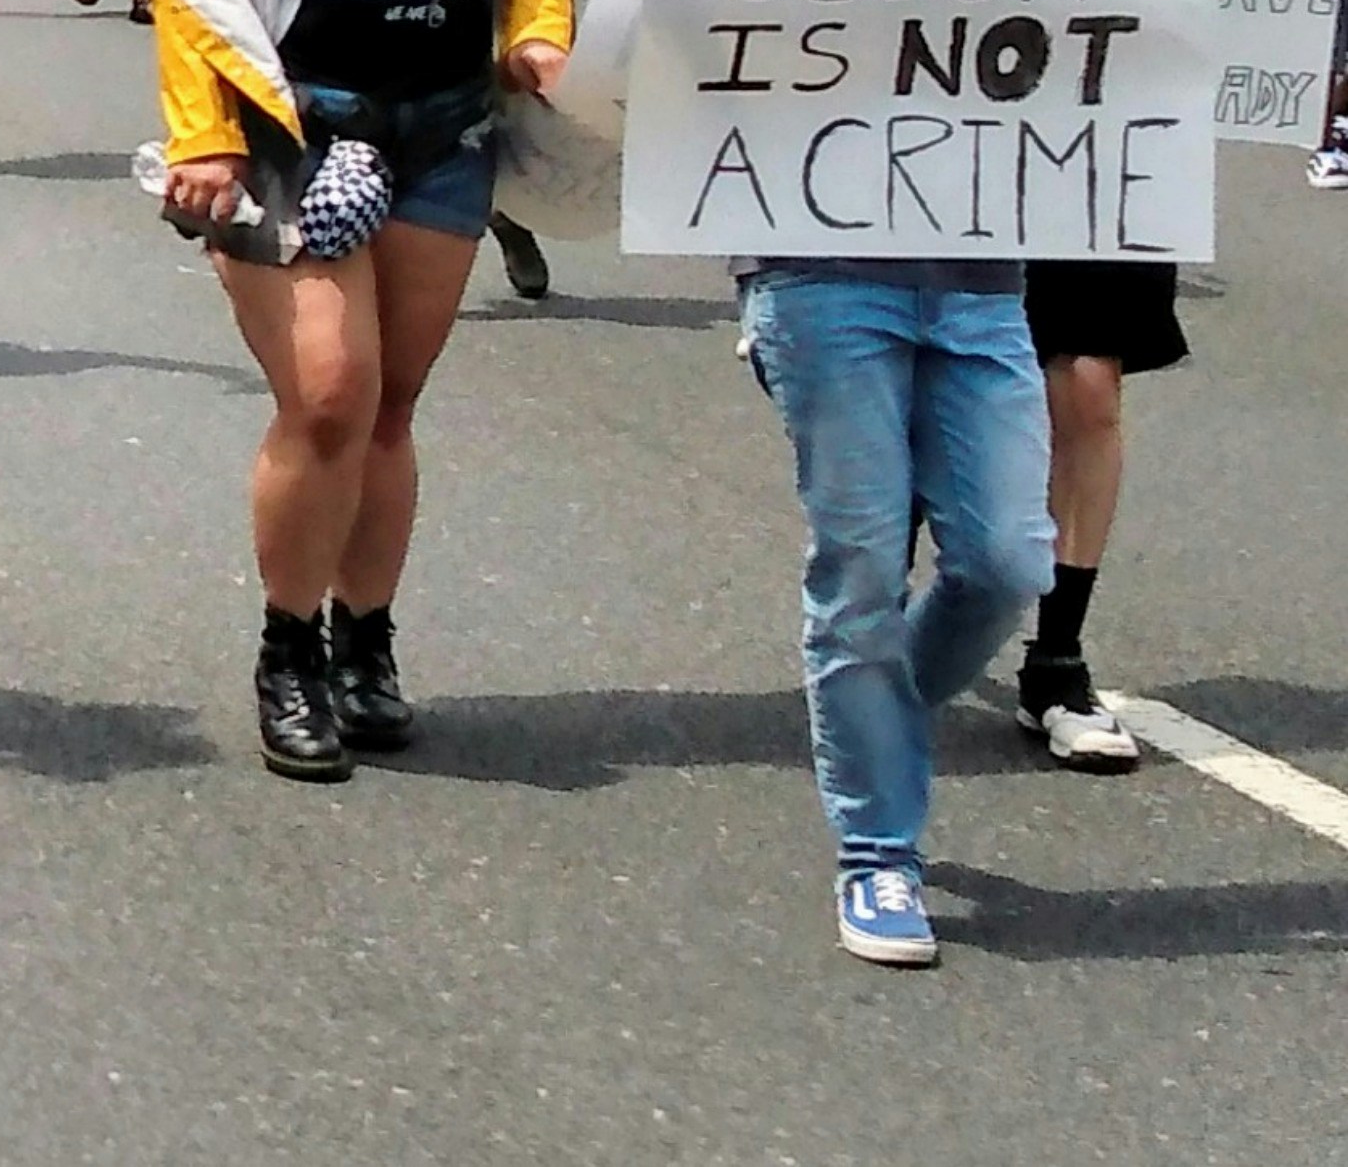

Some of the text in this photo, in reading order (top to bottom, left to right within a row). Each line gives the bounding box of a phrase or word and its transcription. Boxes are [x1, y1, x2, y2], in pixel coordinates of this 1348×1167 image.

[697, 15, 1140, 106] IS NOT
[688, 116, 1182, 253] A CRIME
